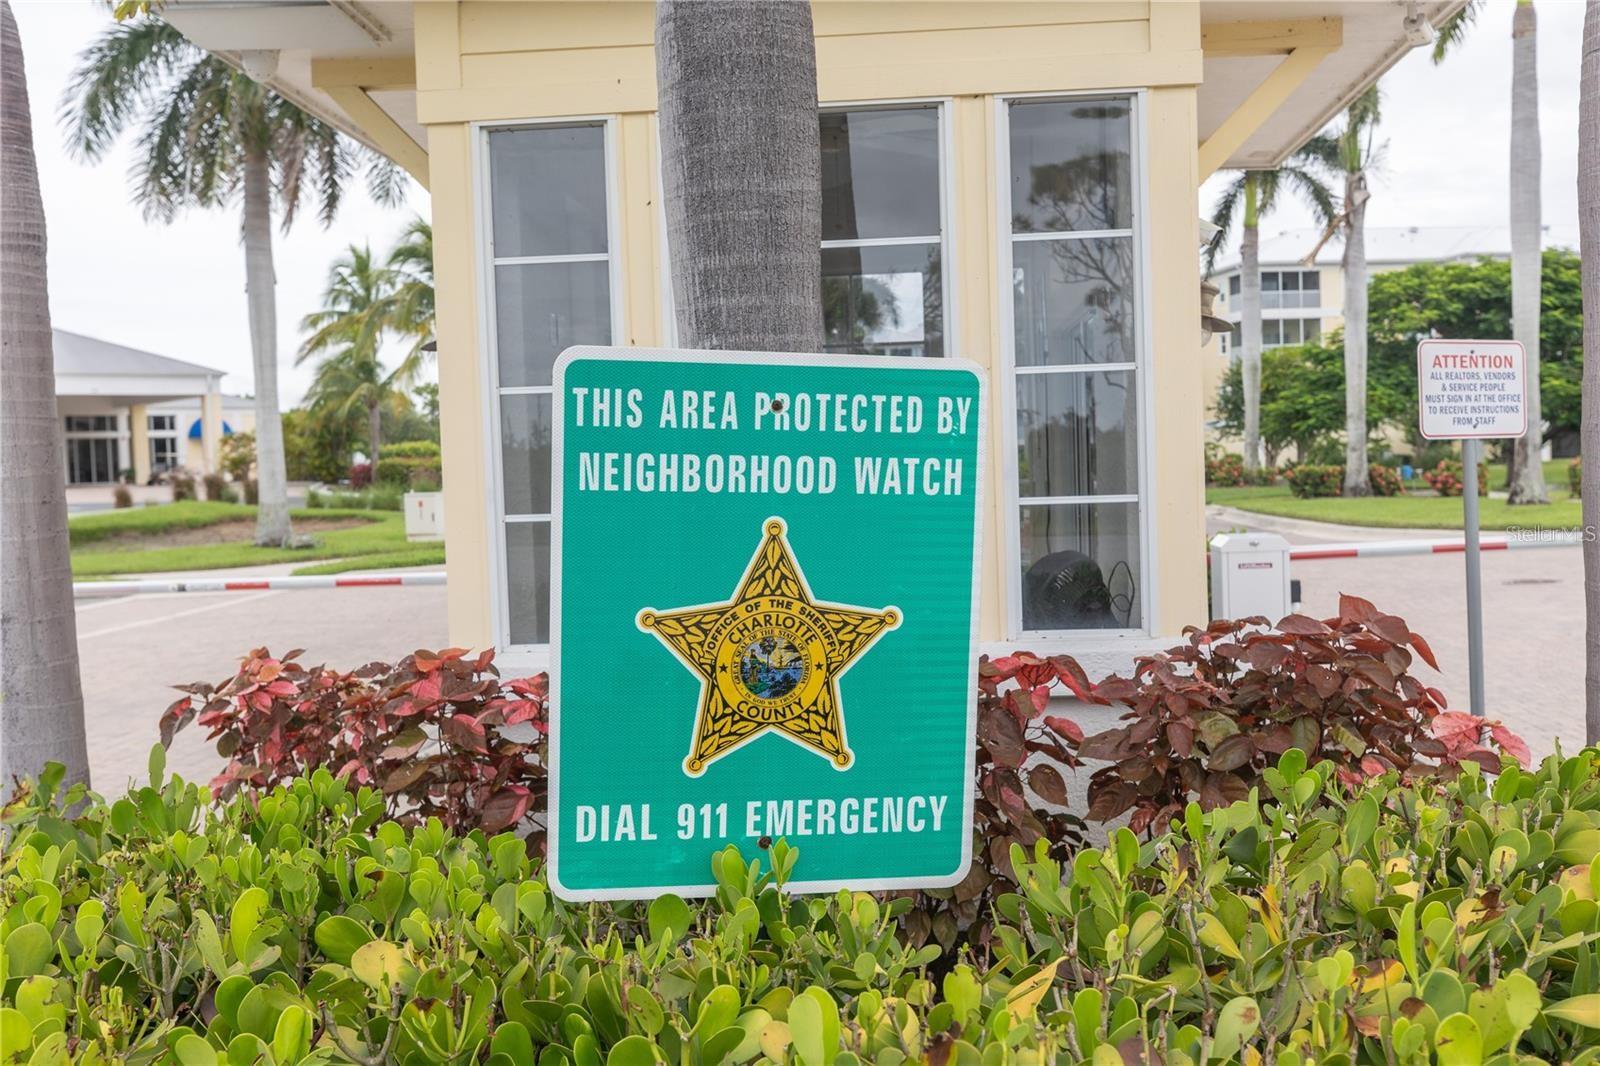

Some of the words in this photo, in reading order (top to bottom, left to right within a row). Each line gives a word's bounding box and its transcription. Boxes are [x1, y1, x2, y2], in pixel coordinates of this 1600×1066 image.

[1432, 355, 1513, 368] ATTENTION
[1430, 372, 1443, 380] ALL
[1484, 372, 1516, 380] VENDORS
[1441, 384, 1447, 392] &
[1498, 394, 1520, 402] OFFICE
[573, 387, 643, 428] THIS
[659, 390, 738, 430] AREA
[754, 391, 923, 434] PROTECTED
[937, 396, 972, 435] BY
[1428, 406, 1437, 414] TO
[1440, 406, 1468, 414] RECEIVE
[1470, 405, 1519, 414] INSTRUCTIONS
[1475, 417, 1496, 425] STAFF
[579, 452, 836, 494] NEIGHBORHOOD
[853, 456, 963, 495] WATCH
[707, 611, 740, 650] OFFICE
[745, 602, 761, 613] OF
[770, 599, 792, 609] THE
[798, 606, 837, 652] SHERIFF
[728, 614, 817, 645] CHARLOTTE
[735, 642, 749, 659] SEAL
[778, 630, 797, 643] STATE
[780, 693, 797, 704] TRUST
[736, 698, 805, 721] COUNTY
[575, 804, 657, 842] DIAL
[677, 802, 728, 839] 911
[746, 795, 948, 837] EMERGENCY
